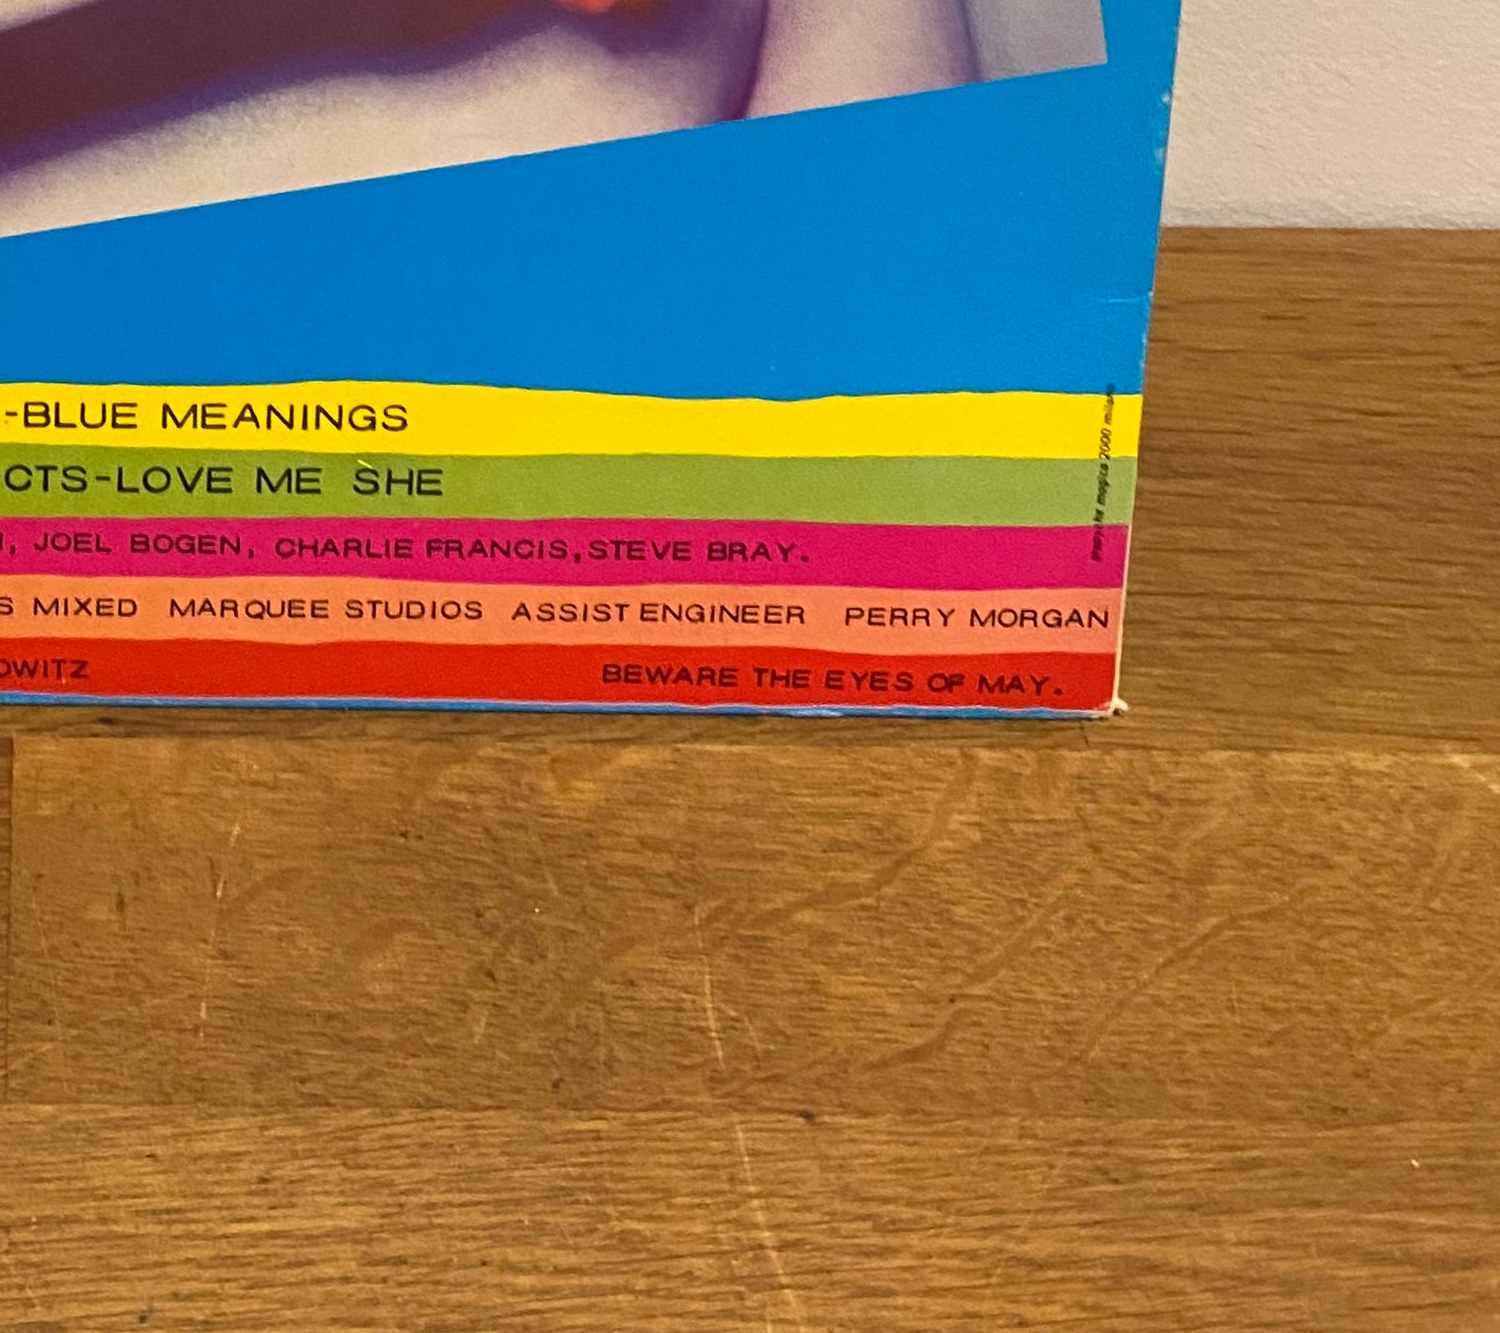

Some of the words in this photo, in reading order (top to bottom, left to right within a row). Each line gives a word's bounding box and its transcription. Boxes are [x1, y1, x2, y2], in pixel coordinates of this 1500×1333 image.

[161, 403, 409, 432] MEANINGS
[1098, 427, 1112, 460] 2000
[255, 468, 323, 495] ME
[352, 468, 444, 496] SHE
[33, 532, 113, 553] JOEL
[130, 534, 256, 559] BOGEN,
[274, 537, 414, 560] CHARLIE
[706, 542, 810, 564] BRAY.
[32, 597, 139, 618] MIXED
[169, 598, 330, 620] MARQUEE
[344, 599, 484, 621] STUDIOS
[511, 602, 629, 623] ASSIST
[640, 603, 806, 625] ENGINEER
[844, 607, 956, 627] PERRY
[968, 607, 1110, 629] MORGAN
[601, 663, 739, 687] BEWARE
[753, 667, 810, 688] THE
[824, 669, 914, 692] EYES
[927, 674, 966, 692] OF
[977, 674, 1064, 697] MAY.
